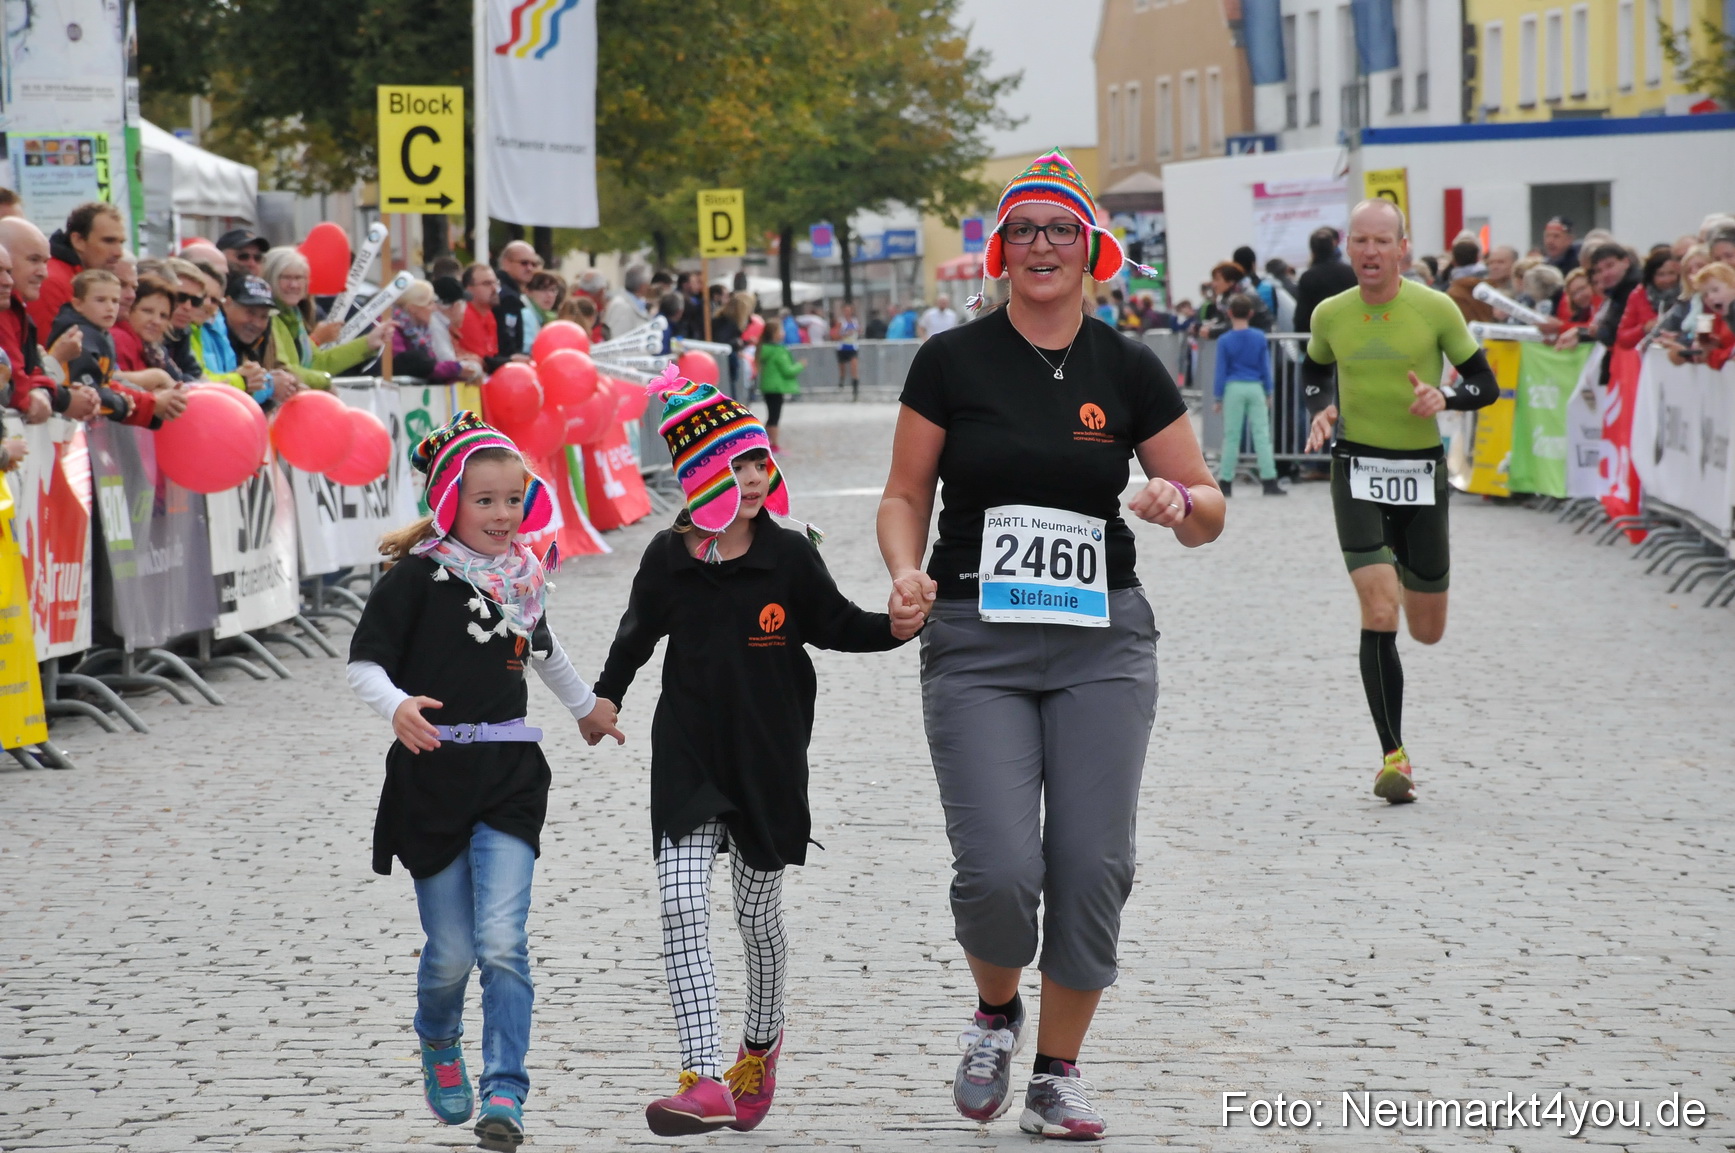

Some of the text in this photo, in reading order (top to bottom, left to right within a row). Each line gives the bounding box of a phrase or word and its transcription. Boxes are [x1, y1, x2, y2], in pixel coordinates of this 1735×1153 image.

[389, 92, 453, 115] Block
[401, 125, 441, 186] C
[705, 194, 736, 206] Block
[712, 210, 733, 241] D
[1354, 465, 1421, 475] ARTL Neumarkt
[1369, 476, 1418, 502] 500
[988, 517, 1088, 536] PARTL Neumarkt
[993, 534, 1097, 585] 2460
[1010, 588, 1079, 609] Stefanie
